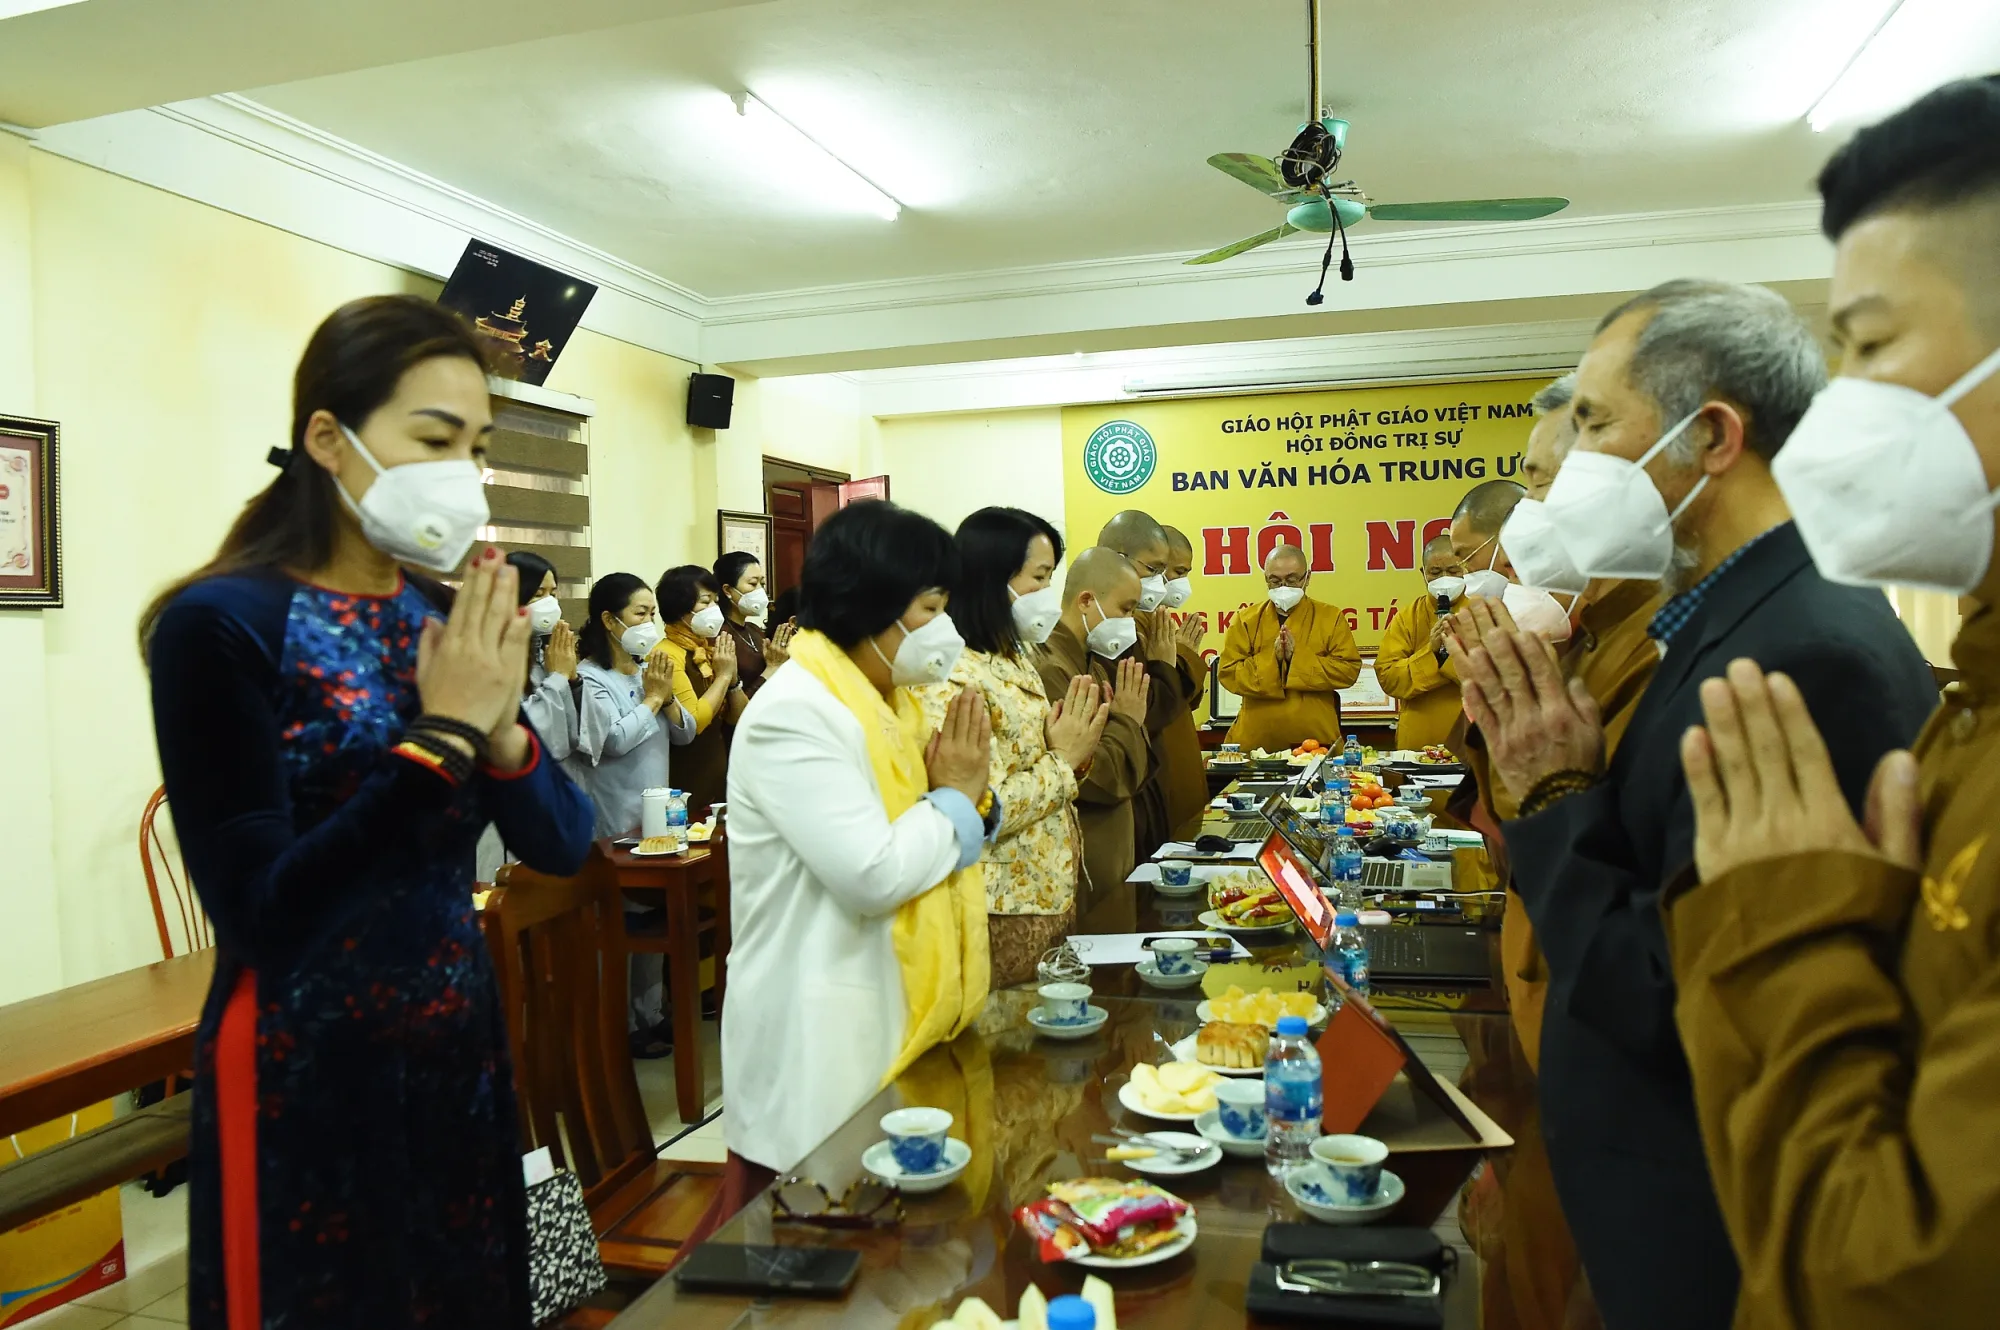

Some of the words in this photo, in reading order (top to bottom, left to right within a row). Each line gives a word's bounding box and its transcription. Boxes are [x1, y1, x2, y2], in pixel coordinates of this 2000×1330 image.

[1221, 414, 1270, 433] GIÁO
[1277, 412, 1313, 433] HỘI
[1320, 409, 1371, 430] PHẬT
[1377, 405, 1428, 425] GIÁO
[1434, 402, 1481, 424] VIỆT
[1487, 403, 1533, 419] NAM
[1088, 443, 1099, 467] GIÁO
[1097, 428, 1112, 443] HỘI
[1115, 426, 1140, 438] PHẬT
[1139, 438, 1152, 462] GIÁO
[1286, 434, 1323, 455] HỘI
[1329, 431, 1387, 451] ĐỒNG
[1393, 432, 1428, 450] TRỊ
[1434, 428, 1463, 448] SỰ
[1100, 476, 1120, 489] VIỆT
[1121, 474, 1142, 489] NAM
[1172, 470, 1229, 492] BAN
[1238, 461, 1297, 489] VĂN
[1308, 457, 1371, 486] HÓA
[1379, 457, 1486, 482] TRUNG
